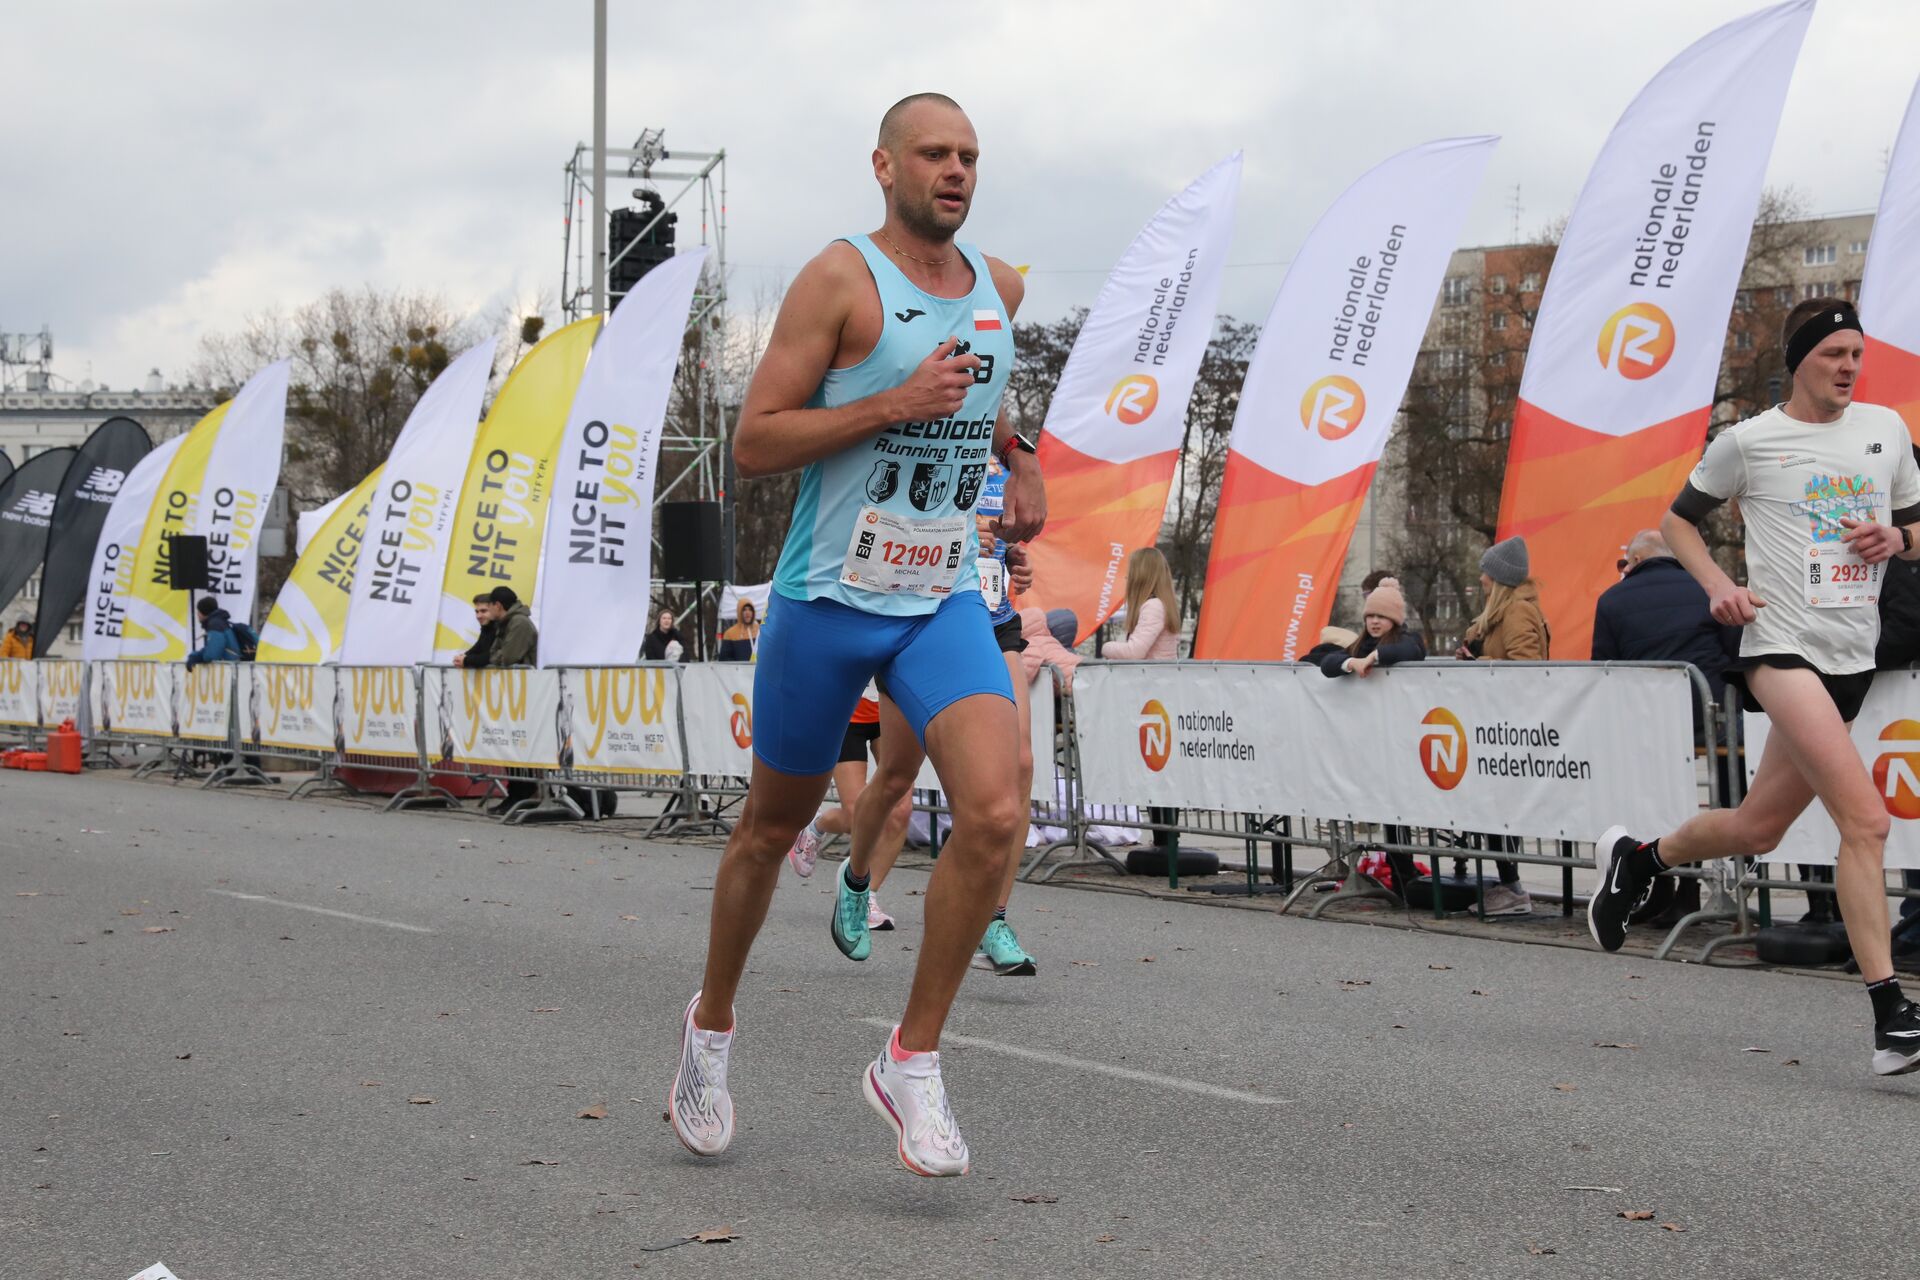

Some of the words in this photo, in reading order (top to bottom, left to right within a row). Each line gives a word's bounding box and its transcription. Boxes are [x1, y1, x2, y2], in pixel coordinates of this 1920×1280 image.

[1629, 163, 1678, 286] nationale
[1656, 121, 1715, 288] nederlanden
[1133, 277, 1173, 363] nationale
[1153, 247, 1198, 366] nederlanden
[1329, 255, 1371, 362] nationale
[1352, 224, 1407, 366] nederlanden
[481, 449, 509, 493] TO
[579, 420, 609, 471] TO
[601, 423, 641, 511] you
[636, 429, 652, 480] NTFY.PL
[874, 437, 949, 462] Running
[954, 445, 988, 459] Team
[213, 487, 234, 525] TO
[385, 479, 412, 522] TO
[499, 452, 536, 528] you
[532, 457, 549, 502] NTFY.PL
[165, 490, 187, 524] TO
[231, 489, 257, 549] you
[403, 482, 439, 553] you
[568, 480, 599, 564] NICE
[103, 543, 120, 577] TO
[207, 532, 229, 593] NICE
[317, 522, 365, 584] NICE
[369, 530, 403, 600] NICE
[467, 501, 499, 576] NICE
[490, 531, 518, 581] FIT
[599, 513, 626, 567] FIT
[881, 540, 943, 567] 12190
[224, 556, 242, 595] FIT
[391, 558, 421, 604] FIT
[1096, 541, 1124, 622] www.nn.pl
[1831, 564, 1868, 582] 2923
[94, 582, 114, 637] NICE
[106, 602, 125, 638] FIT
[1283, 573, 1314, 663] www.nn.pl
[585, 669, 665, 759] you
[1178, 710, 1234, 733] nationale
[1476, 722, 1560, 748] nationale
[1179, 738, 1256, 762] nederlanden
[1477, 752, 1591, 780] nederlanden
